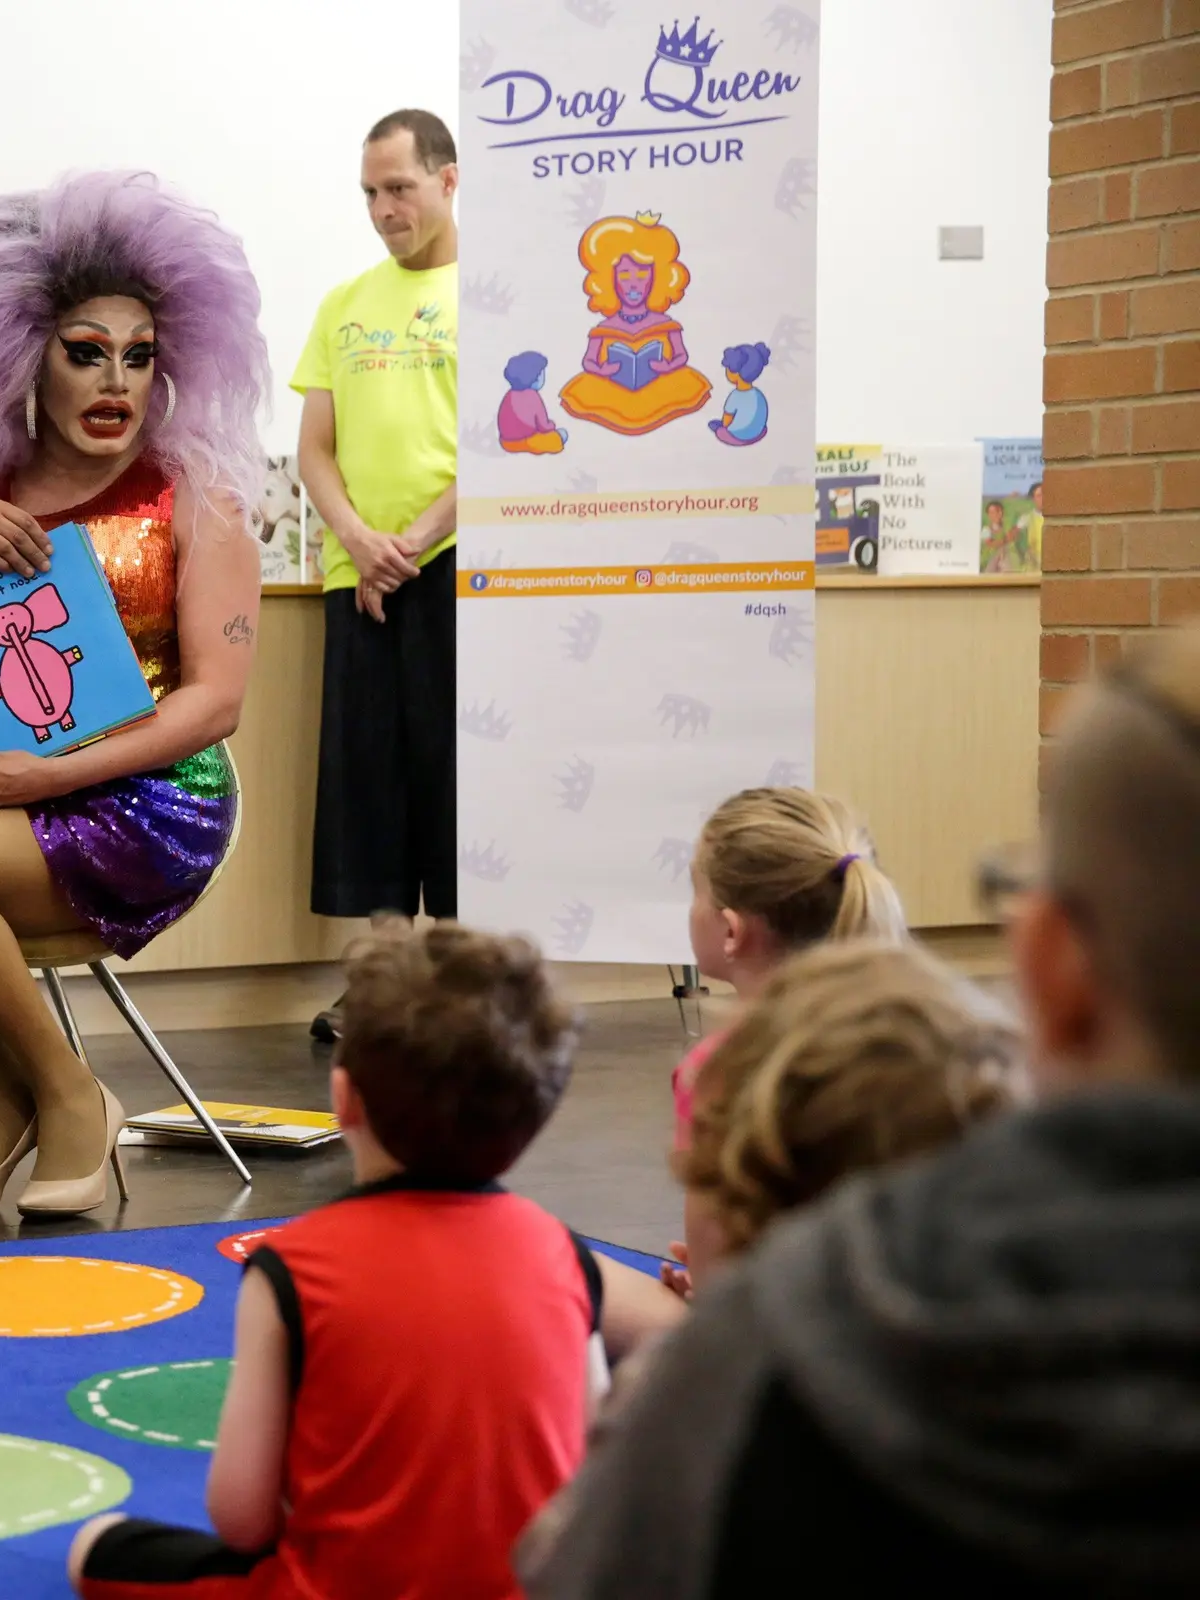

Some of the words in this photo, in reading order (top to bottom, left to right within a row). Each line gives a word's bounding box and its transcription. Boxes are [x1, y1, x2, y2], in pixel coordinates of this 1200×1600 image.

[477, 70, 626, 127] Drag
[641, 52, 801, 119] Queen
[533, 147, 638, 179] STORY
[649, 139, 744, 169] HOUR
[839, 459, 870, 474] BUS
[883, 452, 917, 468] The
[884, 472, 926, 488] Book
[500, 494, 759, 519] www.dragqueenstoryhour.org
[882, 493, 925, 509] With
[882, 515, 907, 530] No
[881, 535, 953, 551] Pictures
[654, 568, 807, 587] @dragqueenstoryhour
[744, 602, 787, 618] #dqsh
